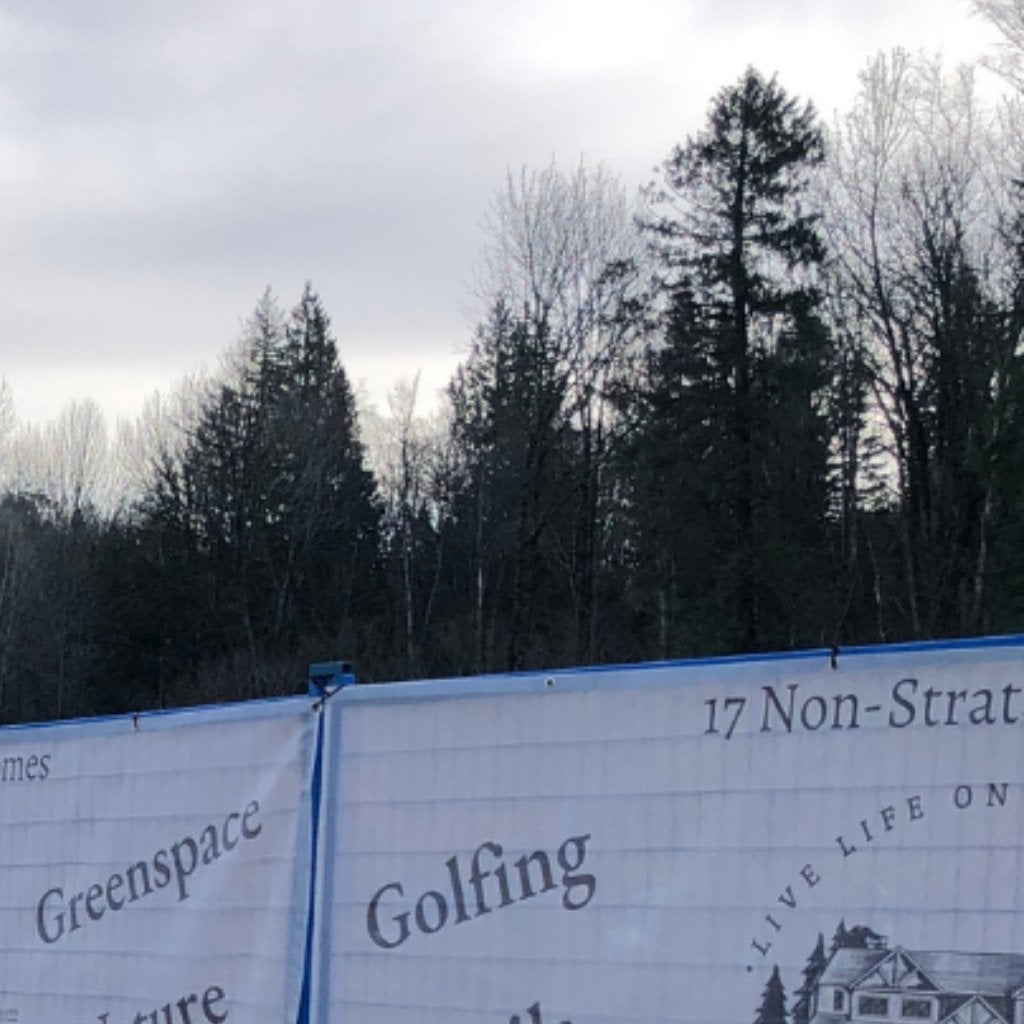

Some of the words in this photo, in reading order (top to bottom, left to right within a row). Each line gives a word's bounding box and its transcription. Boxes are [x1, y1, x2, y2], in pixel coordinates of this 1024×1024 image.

[704, 697, 746, 740] 17
[759, 677, 1023, 734] Non-Strat
[36, 800, 262, 944] Greenspace
[366, 833, 596, 949] Golfing
[751, 864, 822, 957] LIVE
[835, 795, 925, 858] LIFE
[953, 782, 1010, 810] ON
